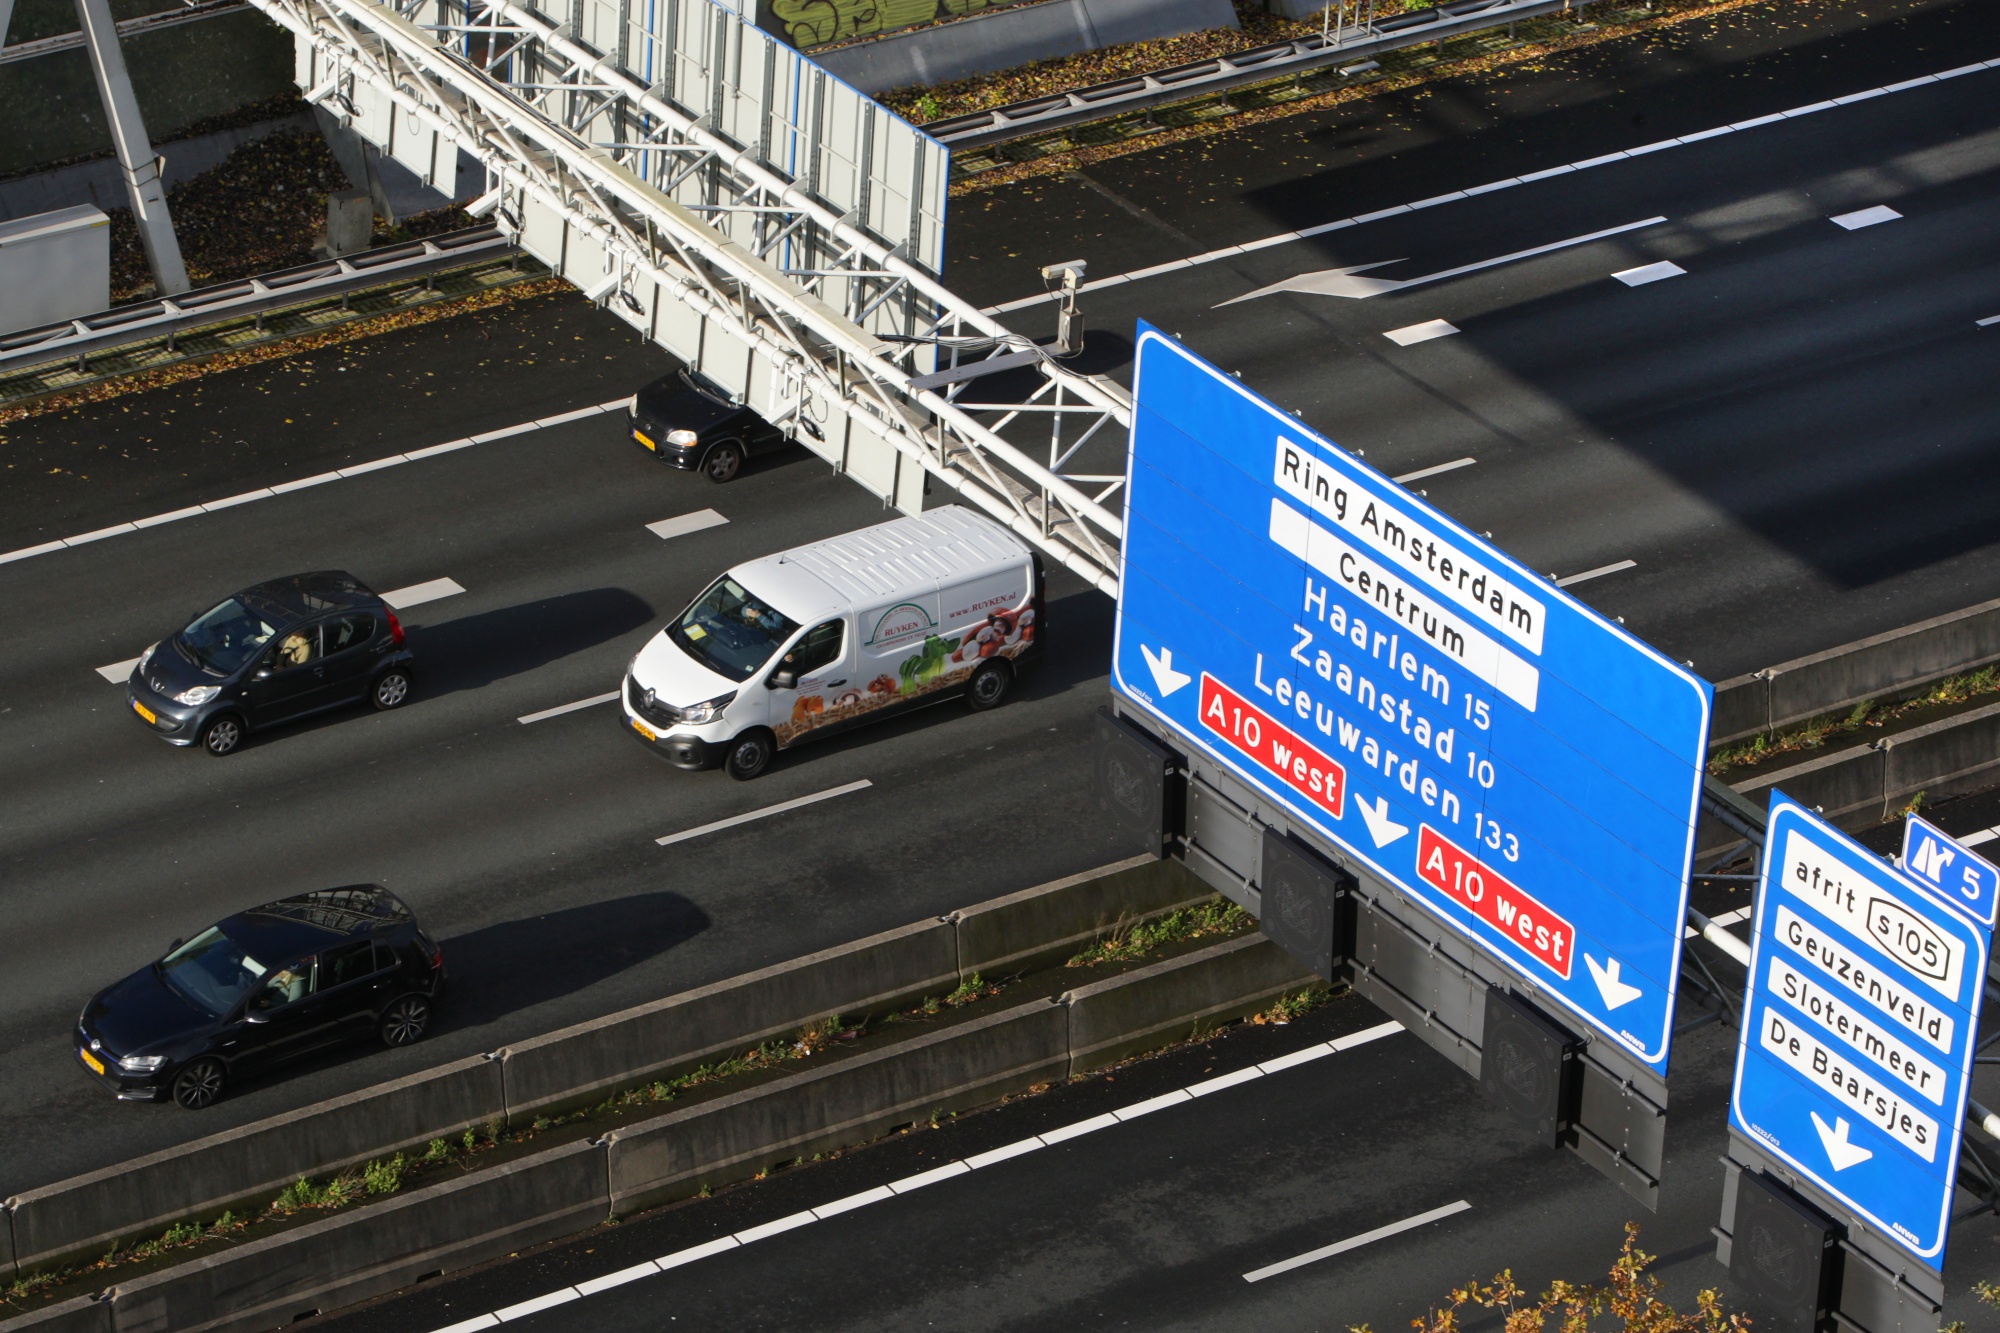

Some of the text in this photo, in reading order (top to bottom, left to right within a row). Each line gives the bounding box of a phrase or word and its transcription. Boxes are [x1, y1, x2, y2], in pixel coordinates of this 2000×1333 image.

[1283, 447, 1533, 635] Ring Amsterdam
[884, 621, 918, 637] RUYKEN
[1304, 577, 1490, 731] Haarlem 15
[1340, 552, 1464, 658] Centrum
[1207, 693, 1337, 803] A10 west
[1254, 652, 1519, 862] Leeuwarden 133
[1290, 623, 1495, 789] Zaanstad 10
[1425, 845, 1566, 962] A10 west
[1796, 861, 1855, 913] afrit
[1960, 865, 1981, 900] 5
[1783, 973, 1931, 1089] Slotermeer
[1788, 920, 1942, 1041] Geuzenveld
[1620, 1029, 1646, 1052] ANWB
[1770, 1018, 1927, 1144] De Baarsjes
[1892, 1221, 1920, 1245] ANWB
